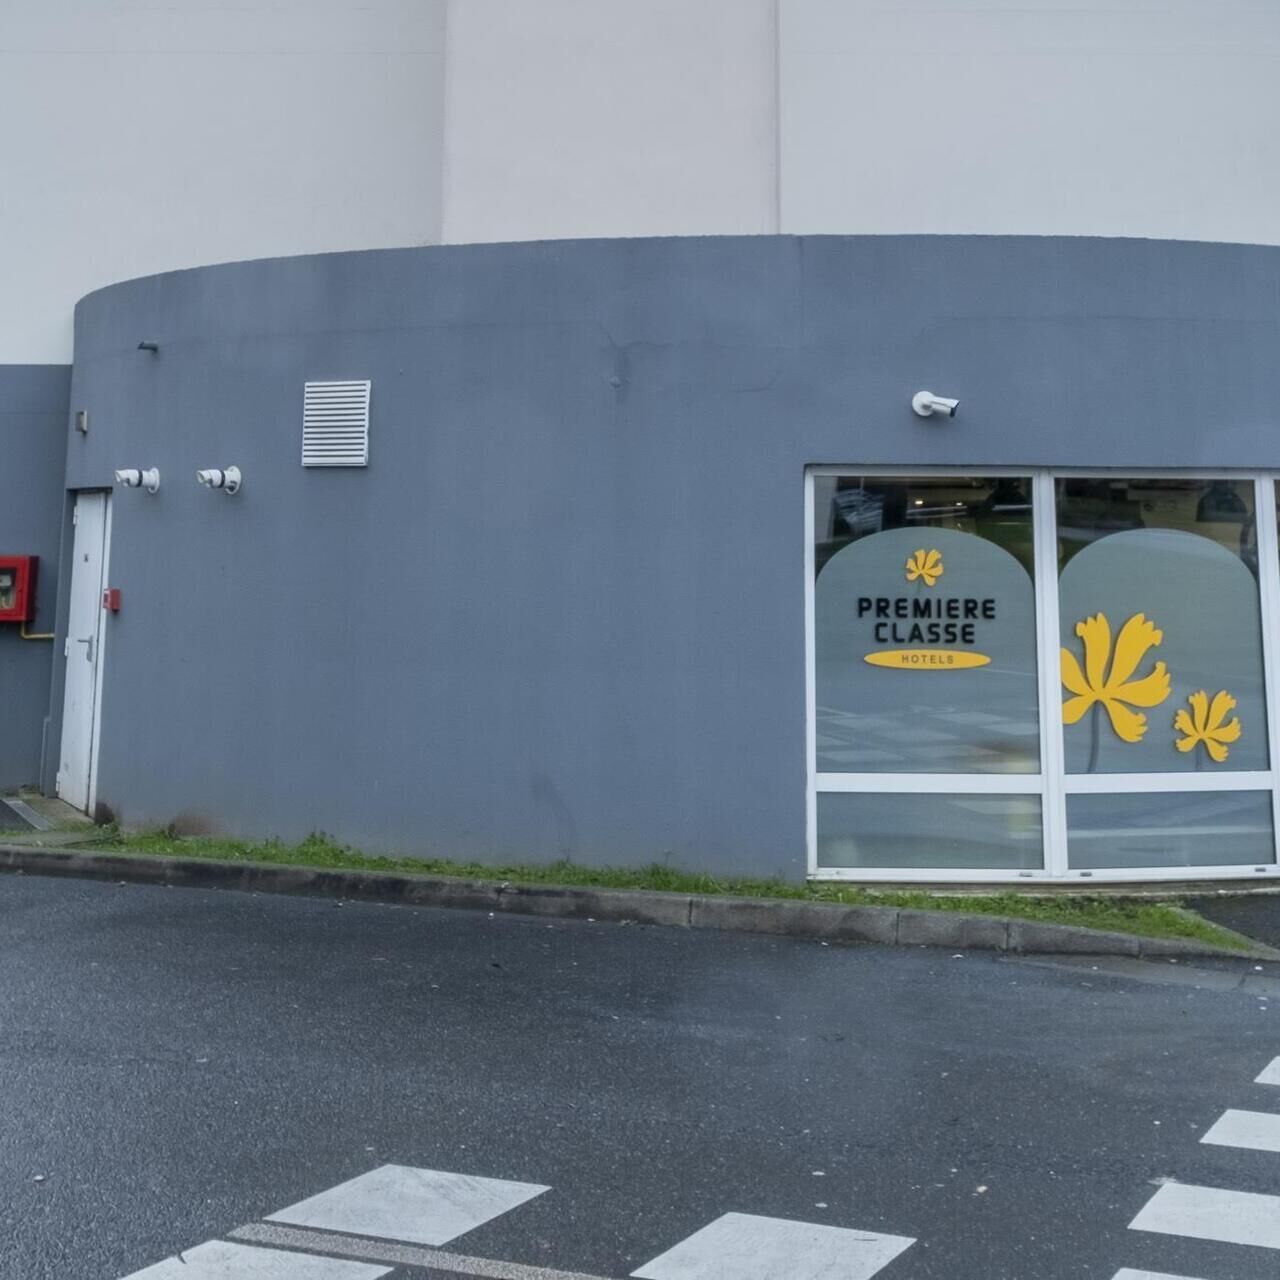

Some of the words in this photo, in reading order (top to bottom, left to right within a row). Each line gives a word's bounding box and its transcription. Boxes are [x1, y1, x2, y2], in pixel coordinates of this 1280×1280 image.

[858, 597, 996, 619] PREMIERE
[874, 622, 975, 643] CLASSE
[901, 654, 955, 664] HOTELS
